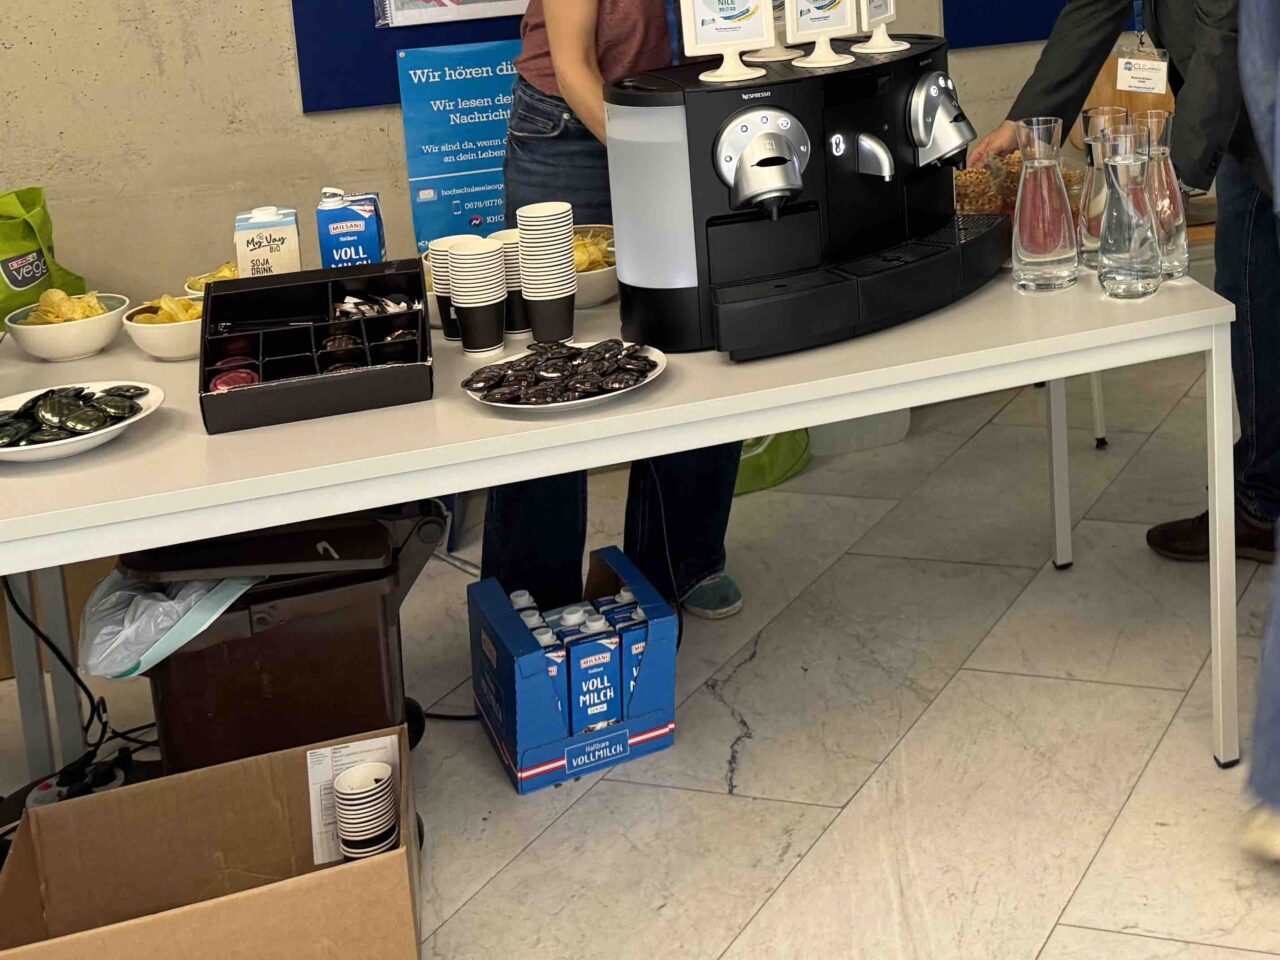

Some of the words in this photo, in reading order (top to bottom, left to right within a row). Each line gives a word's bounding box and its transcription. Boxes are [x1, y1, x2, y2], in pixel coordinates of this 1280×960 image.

[408, 69, 441, 84] Wir
[444, 64, 494, 82] hören
[741, 91, 771, 100] NESPRESSO
[430, 100, 456, 112] Wir
[457, 96, 492, 109] lesen
[422, 144, 440, 154] Wir
[440, 142, 460, 152] sind
[461, 140, 476, 151] da,
[476, 140, 501, 149] wenn
[443, 154, 455, 163] an
[456, 152, 477, 162] dein
[332, 223, 363, 232] MILSANI
[333, 245, 367, 261] VOLL
[250, 258, 270, 268] SOJA
[250, 265, 273, 276] DRINK
[581, 675, 611, 692] VOLL
[579, 686, 614, 708] MILCH
[571, 744, 624, 768] VOLLMILCH
